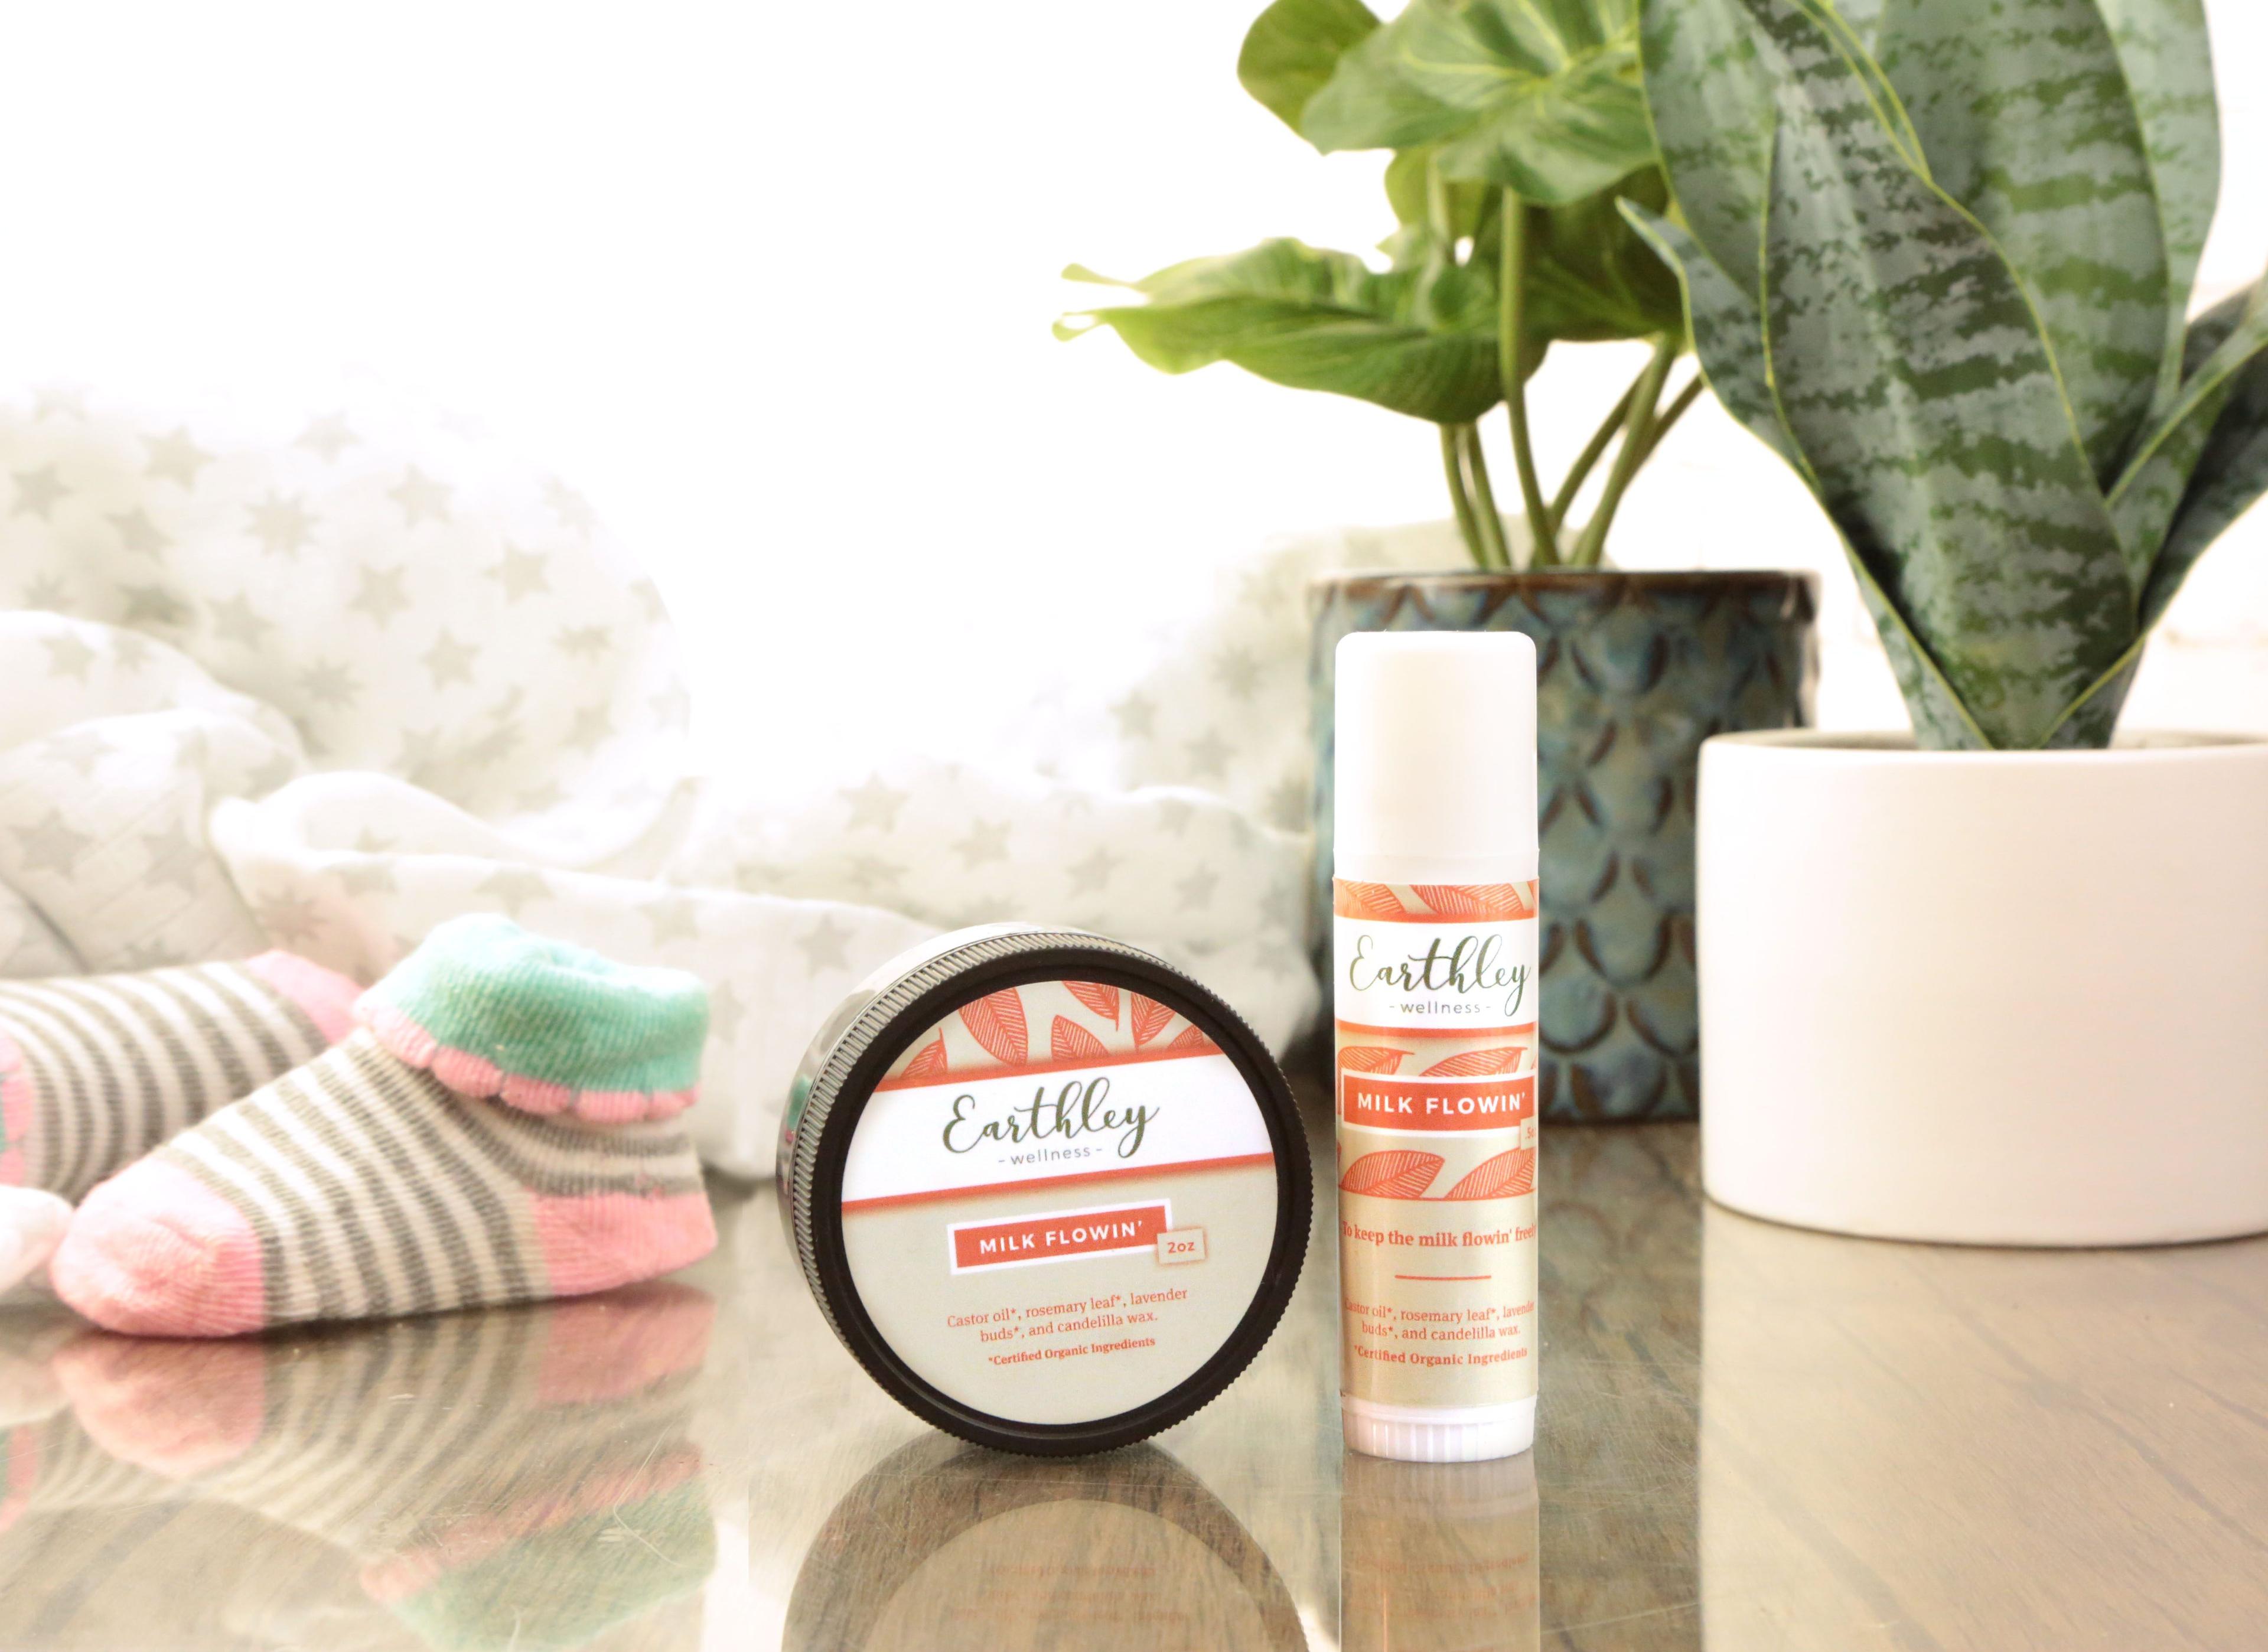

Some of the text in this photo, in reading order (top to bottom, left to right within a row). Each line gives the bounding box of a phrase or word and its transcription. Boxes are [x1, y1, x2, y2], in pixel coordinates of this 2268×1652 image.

[1349, 934, 1531, 1017] Earthley
[1400, 1001, 1480, 1014] wellness
[1358, 1092, 1526, 1116] MILK FLOWIN'
[943, 1077, 1159, 1158] Earthley
[1011, 1149, 1090, 1165] wellness
[980, 1221, 1142, 1254] MILK FLOWIN'
[1342, 1220, 1352, 1237] To
[1354, 1224, 1384, 1246] keep
[1389, 1230, 1414, 1245] the
[1419, 1231, 1458, 1247] milk
[1462, 1229, 1512, 1246] flowin'
[1167, 1242, 1195, 1253] 2oz
[947, 1314, 989, 1328] Castor
[1026, 1300, 1086, 1318] rosemary
[1130, 1289, 1188, 1305] lavender
[1401, 1311, 1463, 1324] rosemary
[1029, 1322, 1054, 1336] and
[1058, 1317, 1123, 1332] candelilla
[1127, 1312, 1158, 1324] wax.
[1402, 1328, 1427, 1340] and
[1432, 1326, 1495, 1340] candelilla
[1499, 1325, 1520, 1337] wax.
[1045, 1345, 1088, 1360] Organic
[1091, 1337, 1155, 1354] Ingredients
[1410, 1353, 1463, 1367] Organic
[1468, 1347, 1527, 1366] Ingredients
